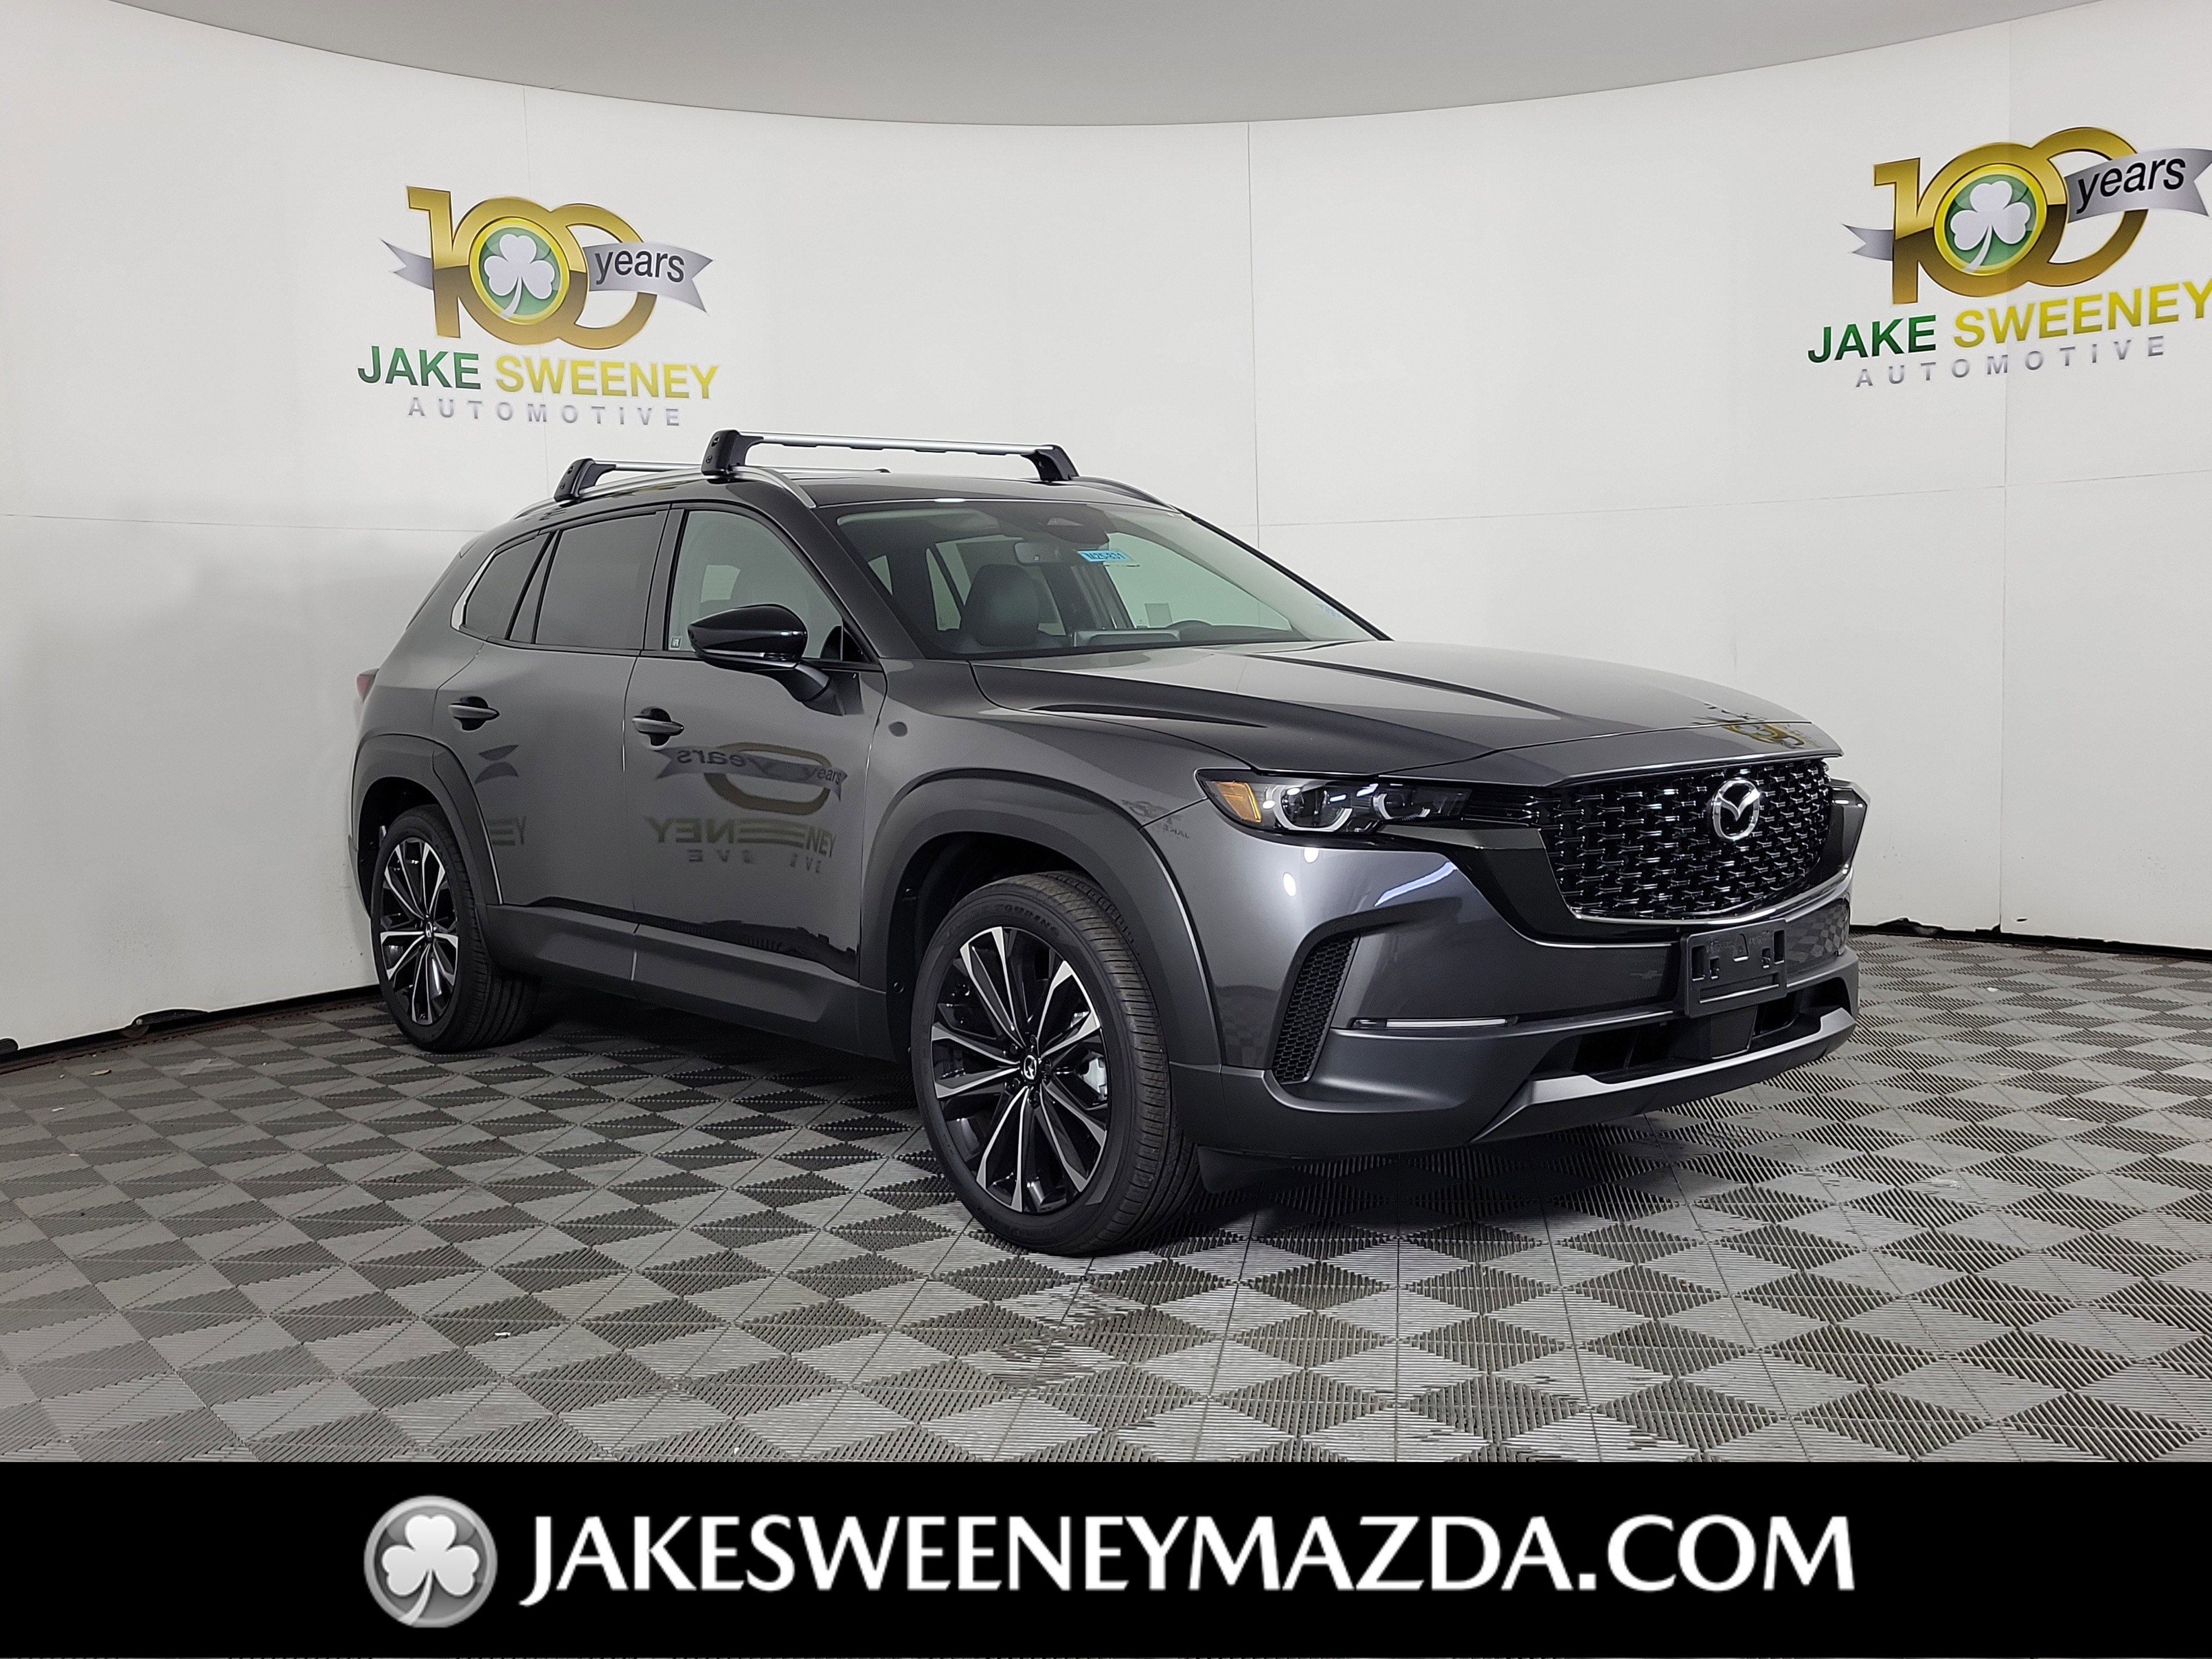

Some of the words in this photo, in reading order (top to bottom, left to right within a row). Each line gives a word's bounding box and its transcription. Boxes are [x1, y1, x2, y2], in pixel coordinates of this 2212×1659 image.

[2075, 157, 2186, 215] years
[595, 249, 685, 284] years
[1807, 314, 1937, 363] JAKE
[1953, 278, 2212, 348] SWEENEY
[357, 345, 481, 390] JAKE
[495, 354, 720, 399] SWEENEY
[1855, 335, 2165, 388] AUTOMOTIVE
[408, 397, 680, 427] AUTOMOTIVE
